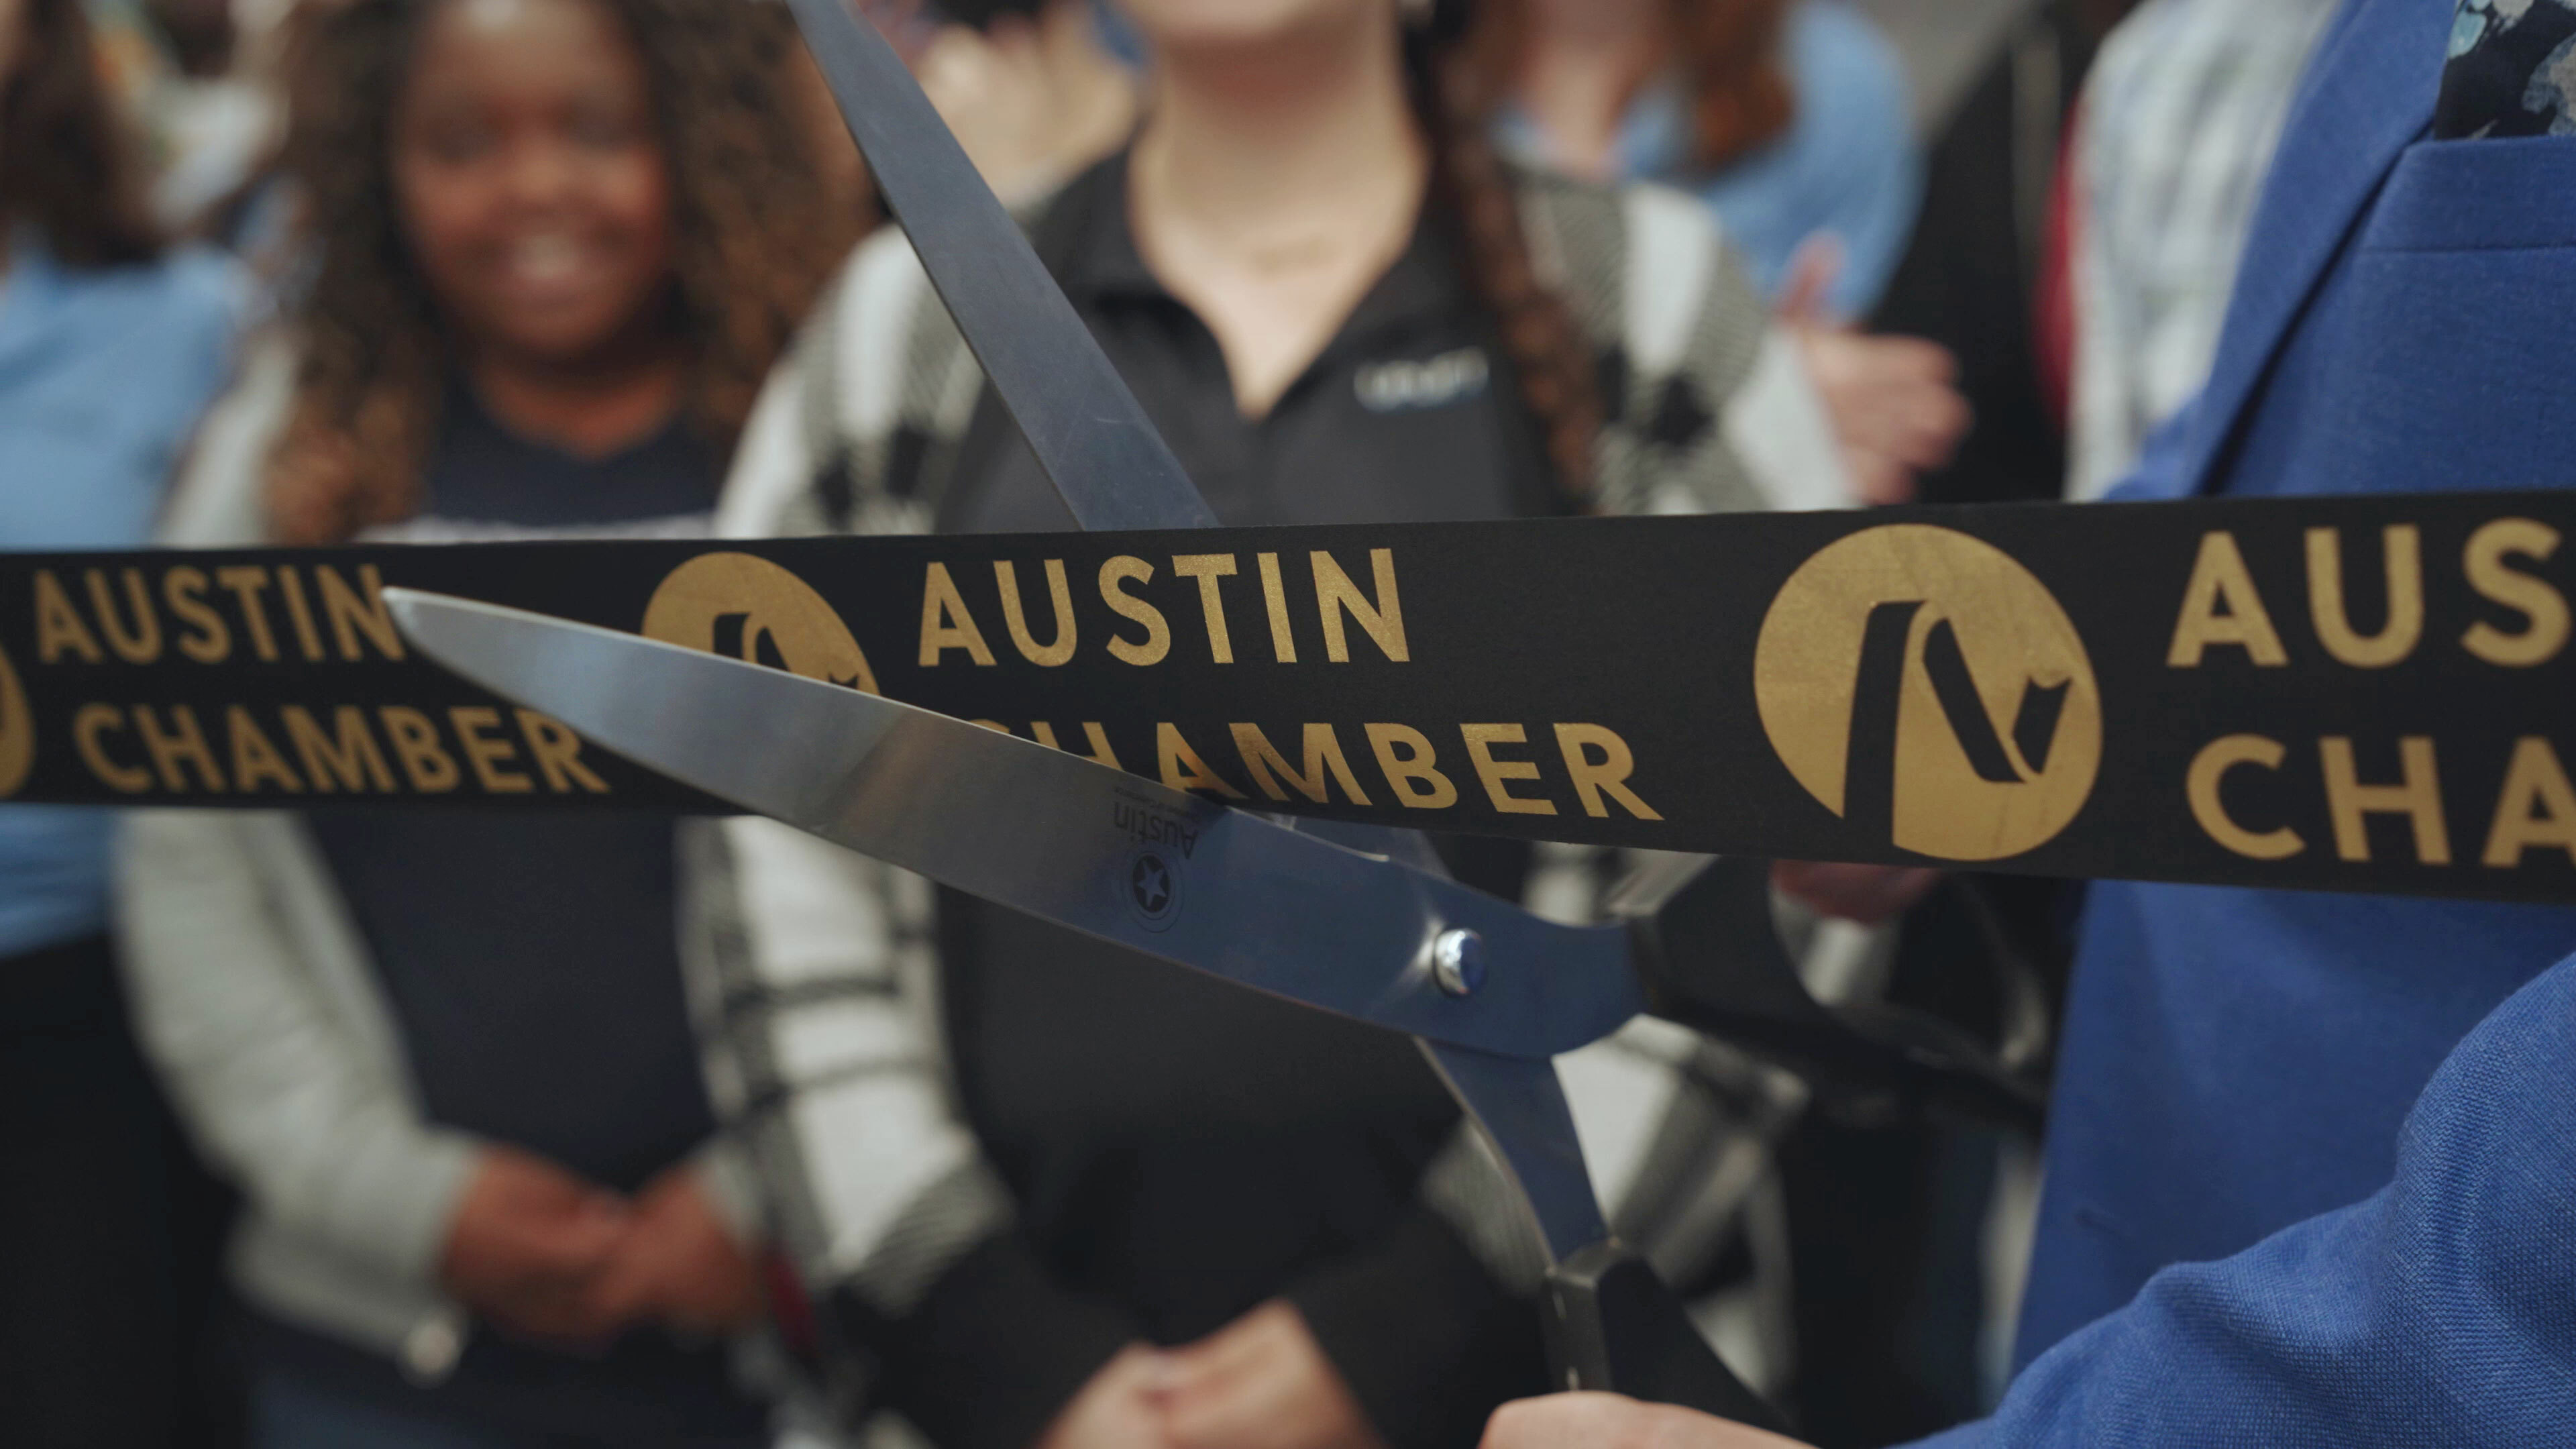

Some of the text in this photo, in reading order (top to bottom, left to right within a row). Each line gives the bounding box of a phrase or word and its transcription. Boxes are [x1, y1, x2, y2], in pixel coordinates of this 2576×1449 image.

[34, 562, 405, 663] AUSTIN
[918, 547, 1410, 667] AUSTIN
[73, 704, 609, 793] CHAMBER
[966, 718, 1665, 822] HAMBER
[1114, 801, 1199, 861] Austin
